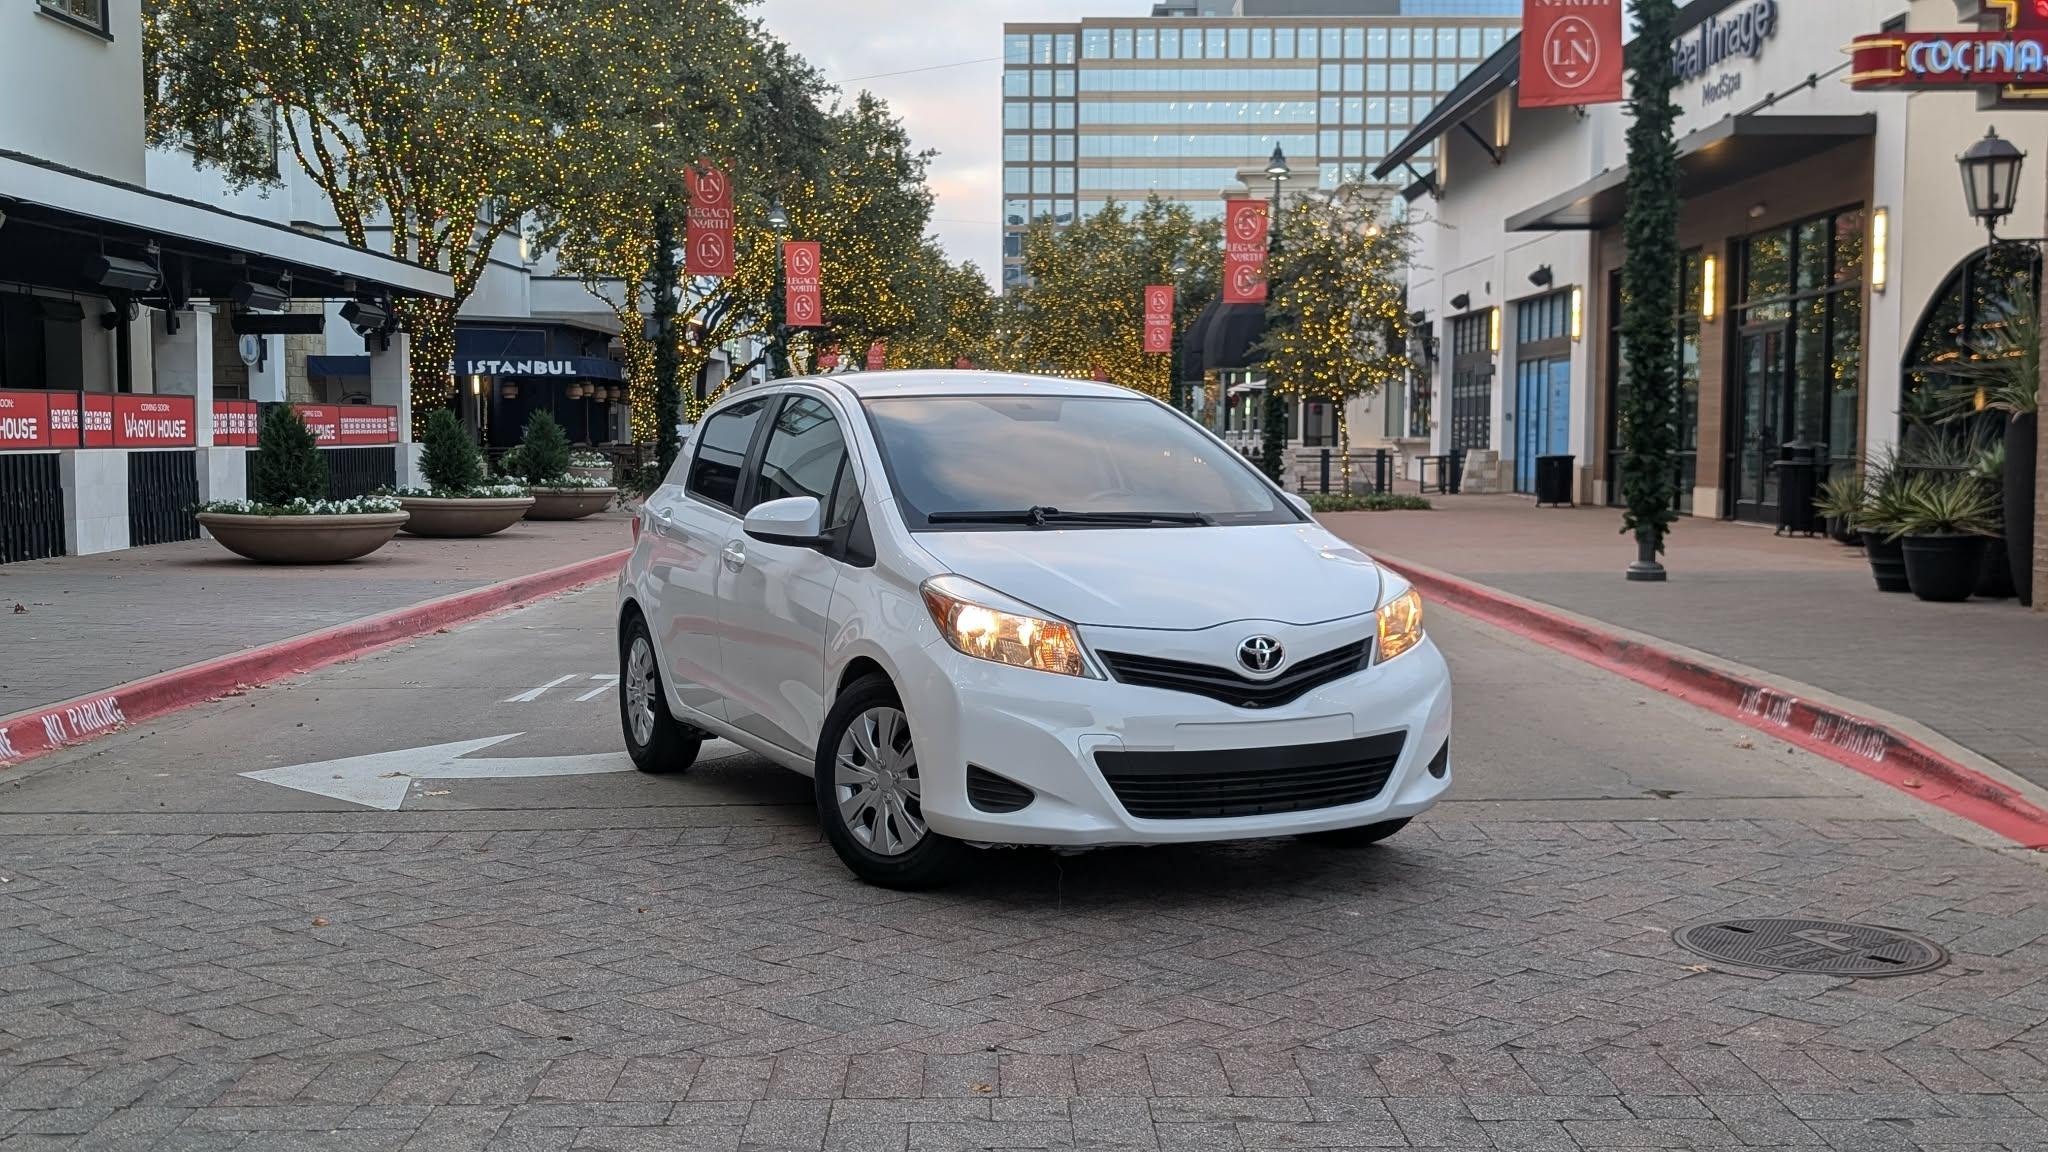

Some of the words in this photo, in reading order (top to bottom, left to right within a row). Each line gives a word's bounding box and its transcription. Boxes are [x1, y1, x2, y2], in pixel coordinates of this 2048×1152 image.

[1706, 0, 1776, 66] Image
[1552, 39, 1591, 65] LN
[1905, 39, 2043, 74] COCINA
[1702, 72, 1742, 107] MedSpa
[700, 179, 720, 192] LN
[688, 207, 730, 218] LEGACY
[692, 219, 729, 229] NORTH
[701, 243, 721, 257] LN
[795, 256, 811, 267] LN
[787, 277, 818, 285] LEGACY
[790, 285, 817, 293] NORTH
[796, 302, 811, 313] LN
[467, 360, 577, 375] ISTANBUL
[140, 403, 157, 412] COMING
[0, 417, 38, 440] HOUSE
[123, 412, 156, 438] WAGYU
[157, 419, 187, 438] HOUSE
[41, 713, 67, 745] NO
[66, 696, 126, 736] PARKING
